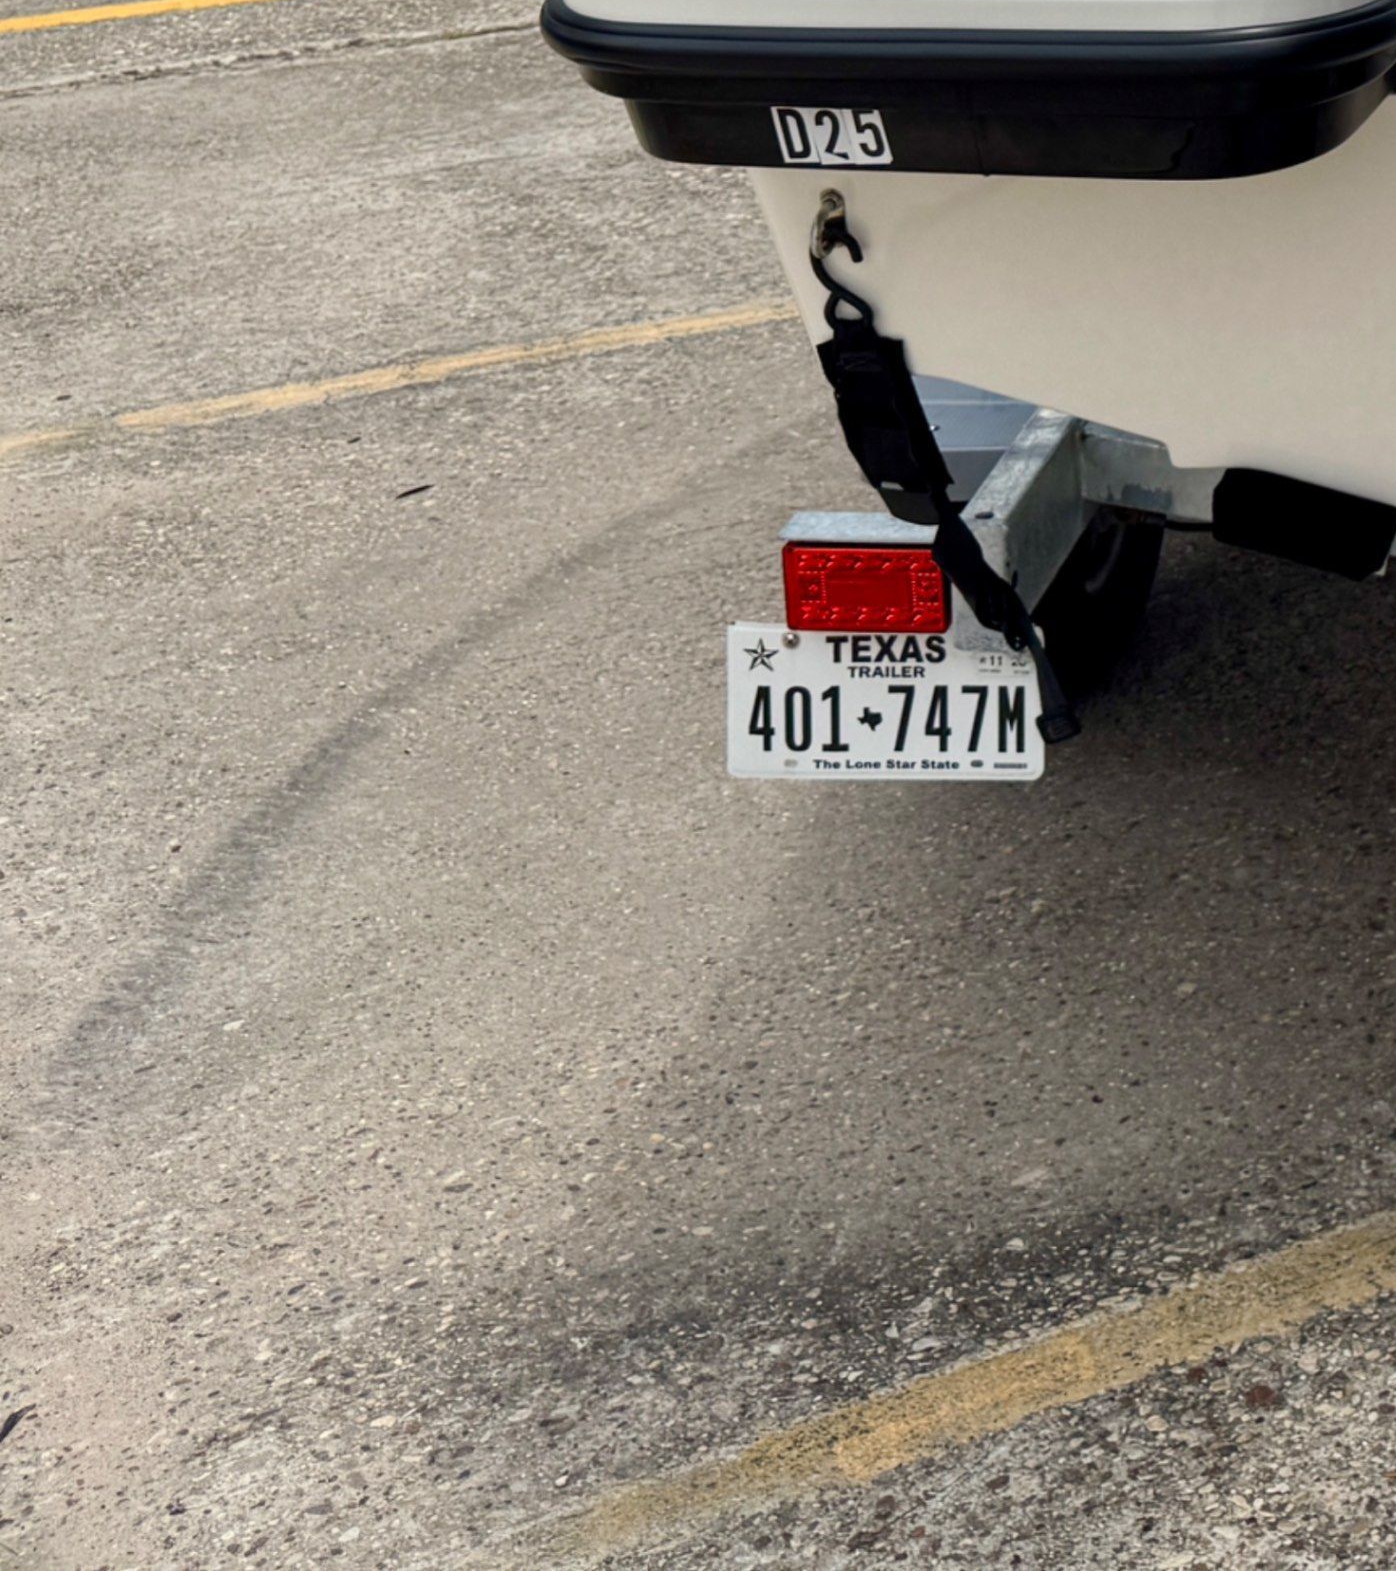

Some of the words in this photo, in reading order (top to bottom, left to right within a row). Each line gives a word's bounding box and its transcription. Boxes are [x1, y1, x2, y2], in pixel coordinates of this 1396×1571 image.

[776, 107, 885, 159] D25
[826, 634, 946, 663] TEXAS
[848, 665, 926, 678] TRAILER
[748, 685, 849, 752] 401
[888, 684, 1025, 753] 747M
[813, 758, 843, 770] The
[846, 758, 879, 770] Lone
[886, 758, 918, 770] Star
[921, 758, 960, 770] State
